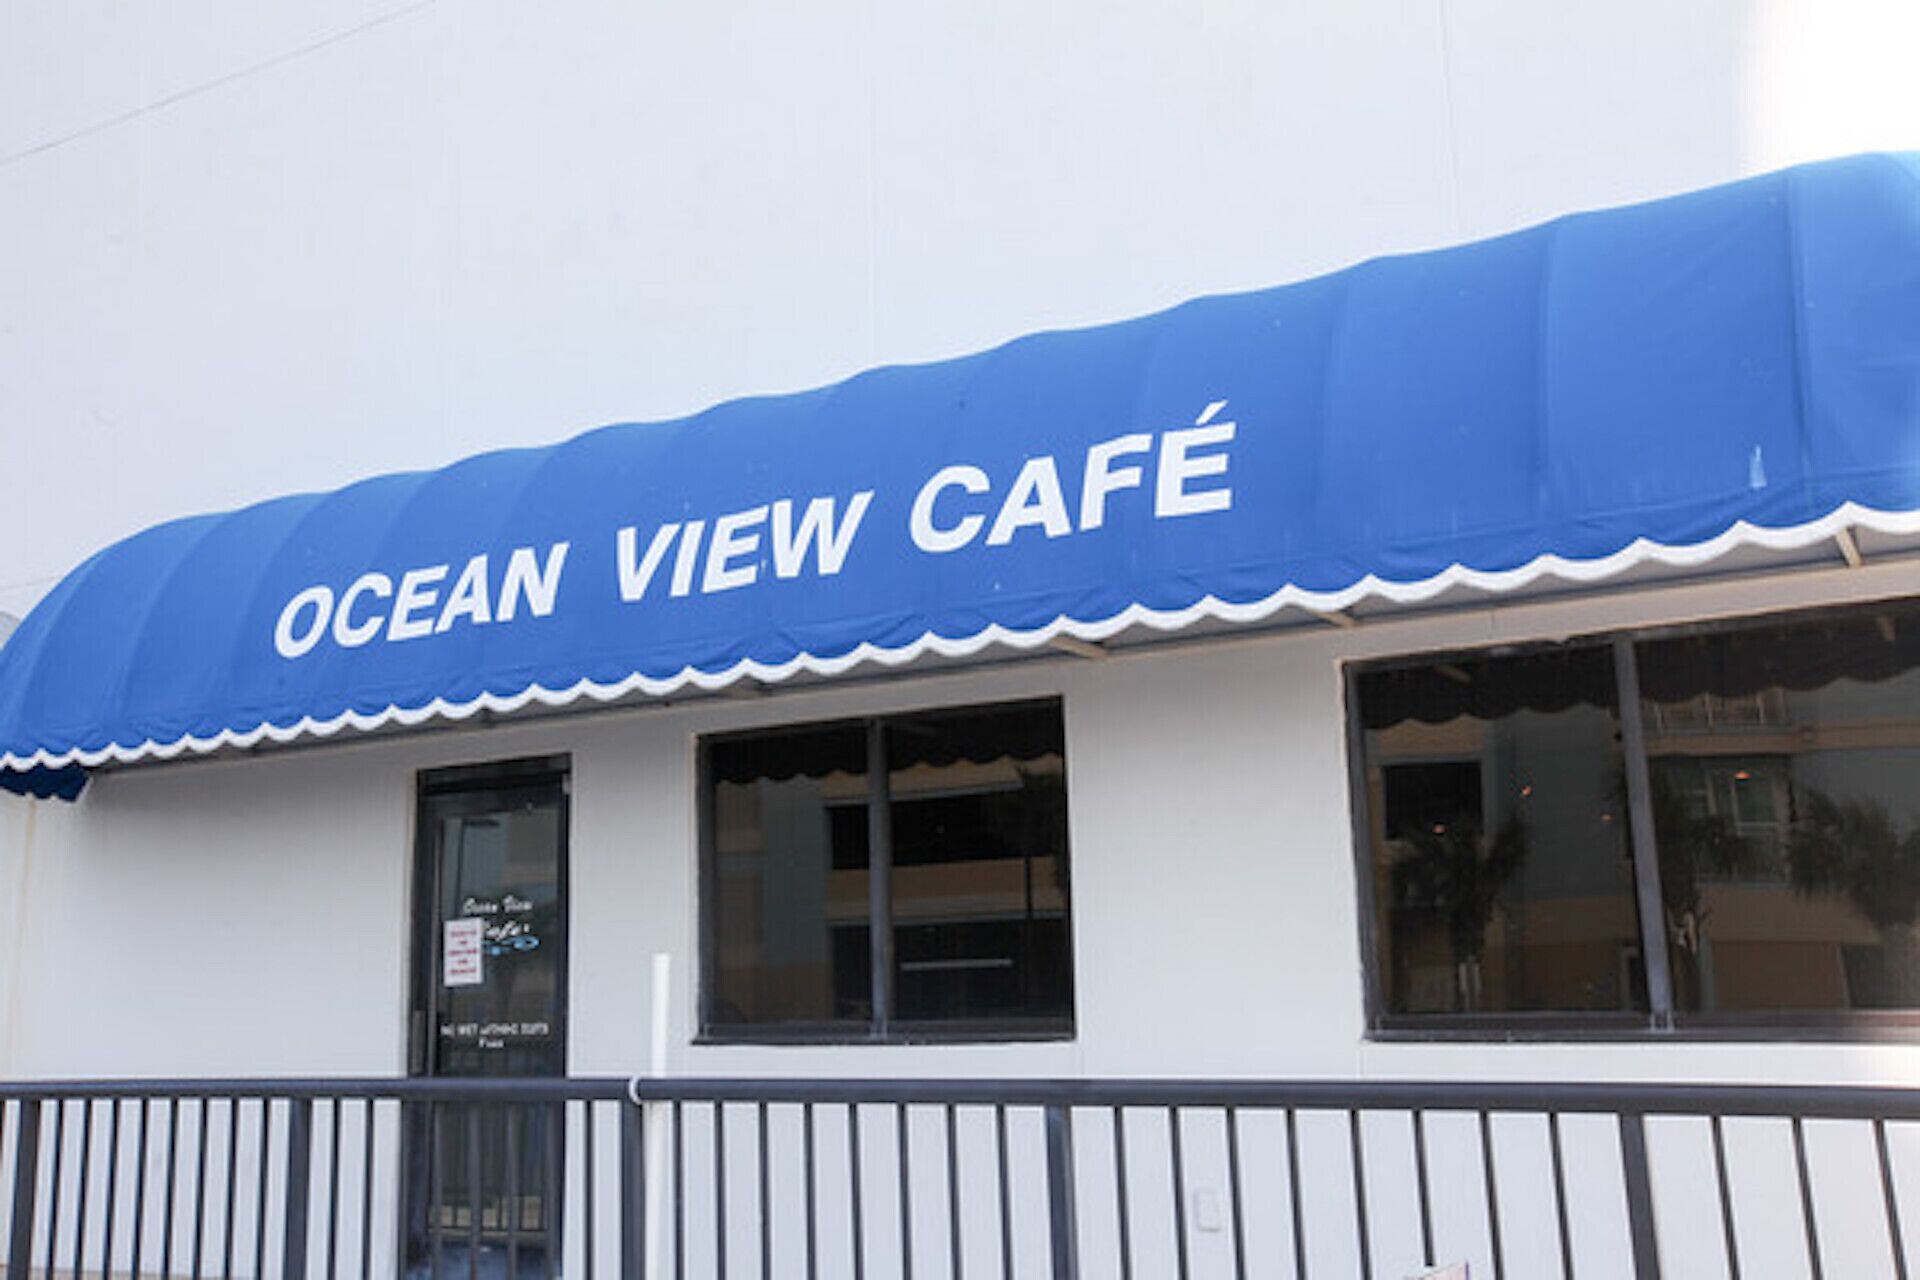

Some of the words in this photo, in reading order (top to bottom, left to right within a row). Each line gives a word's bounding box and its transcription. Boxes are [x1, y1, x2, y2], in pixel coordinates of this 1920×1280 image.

[274, 542, 570, 658] OCEAN
[617, 490, 875, 602] VIEW
[909, 399, 1237, 553] CAFÉ
